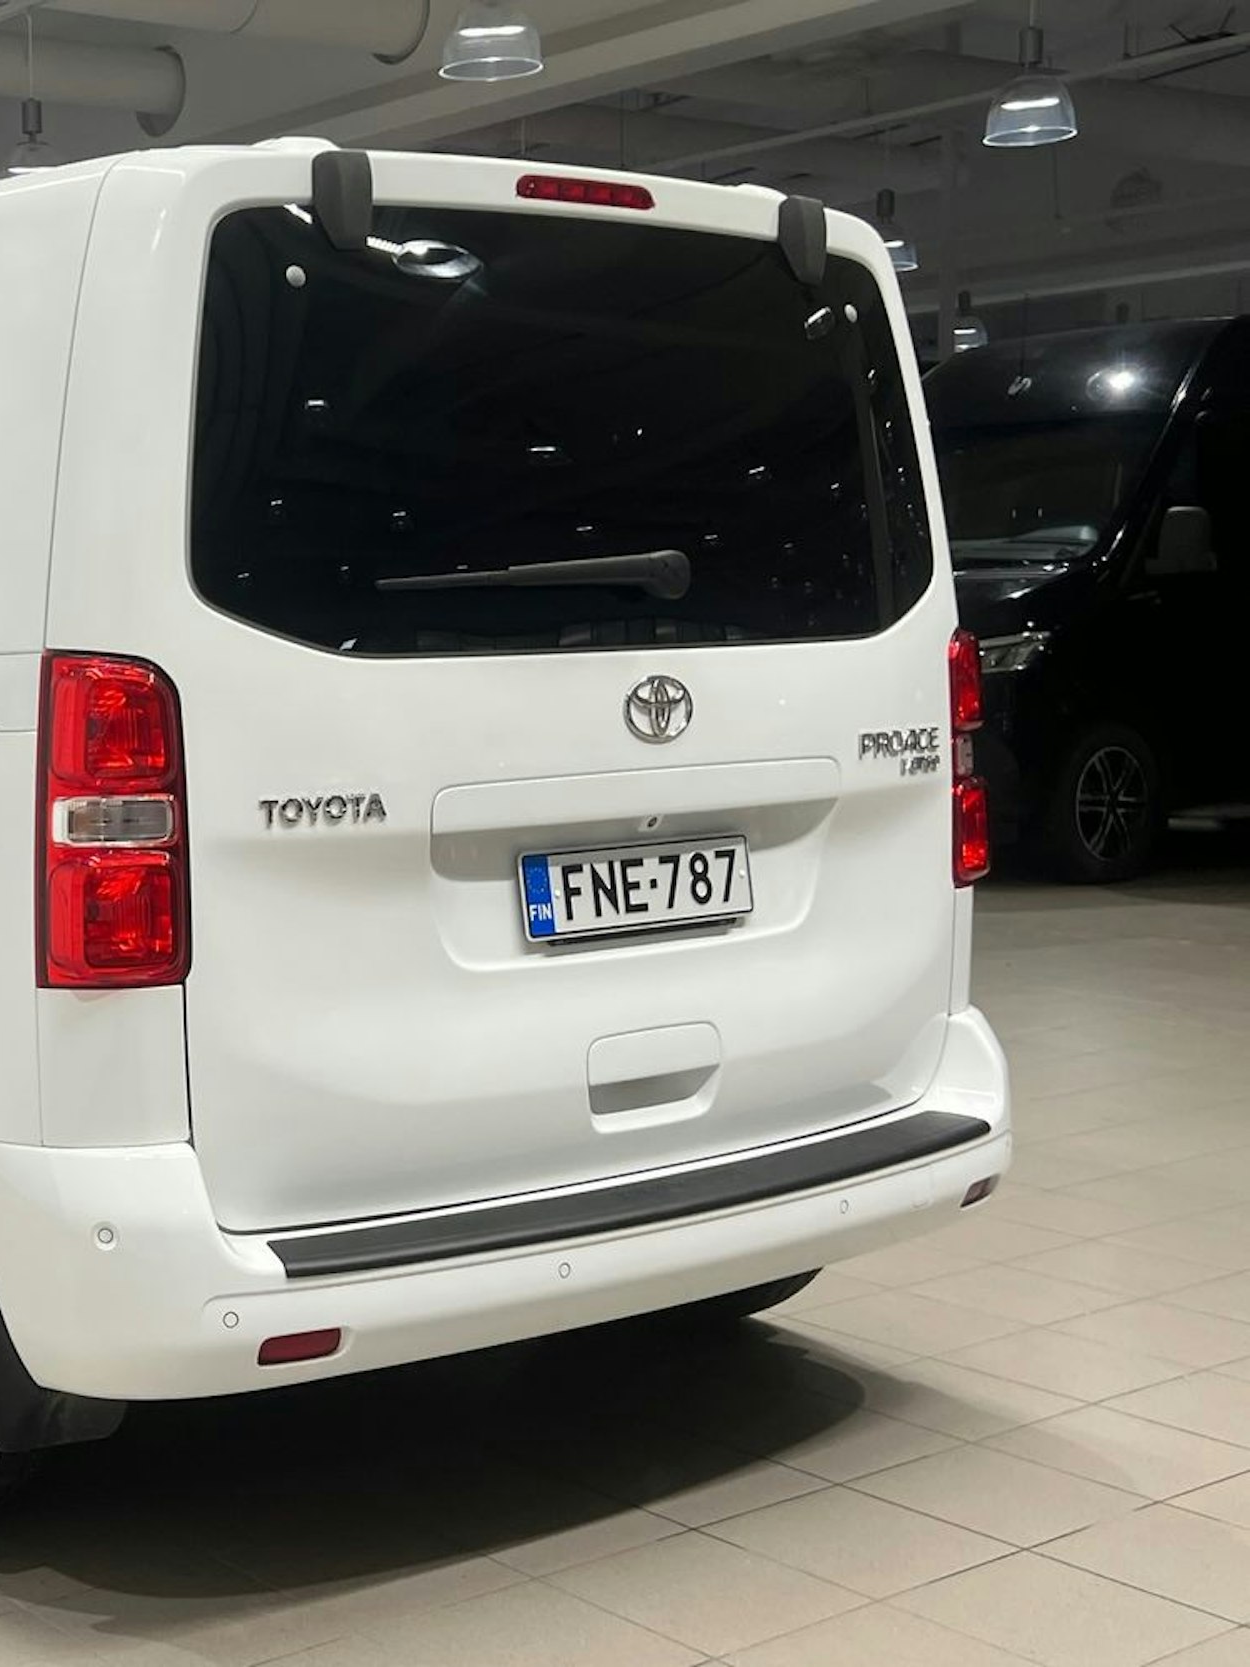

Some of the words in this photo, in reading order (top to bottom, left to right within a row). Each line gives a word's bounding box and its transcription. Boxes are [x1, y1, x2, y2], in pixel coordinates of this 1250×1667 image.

[858, 727, 940, 760] PROACE
[258, 793, 387, 829] TOYOTA
[529, 902, 553, 922] FIN
